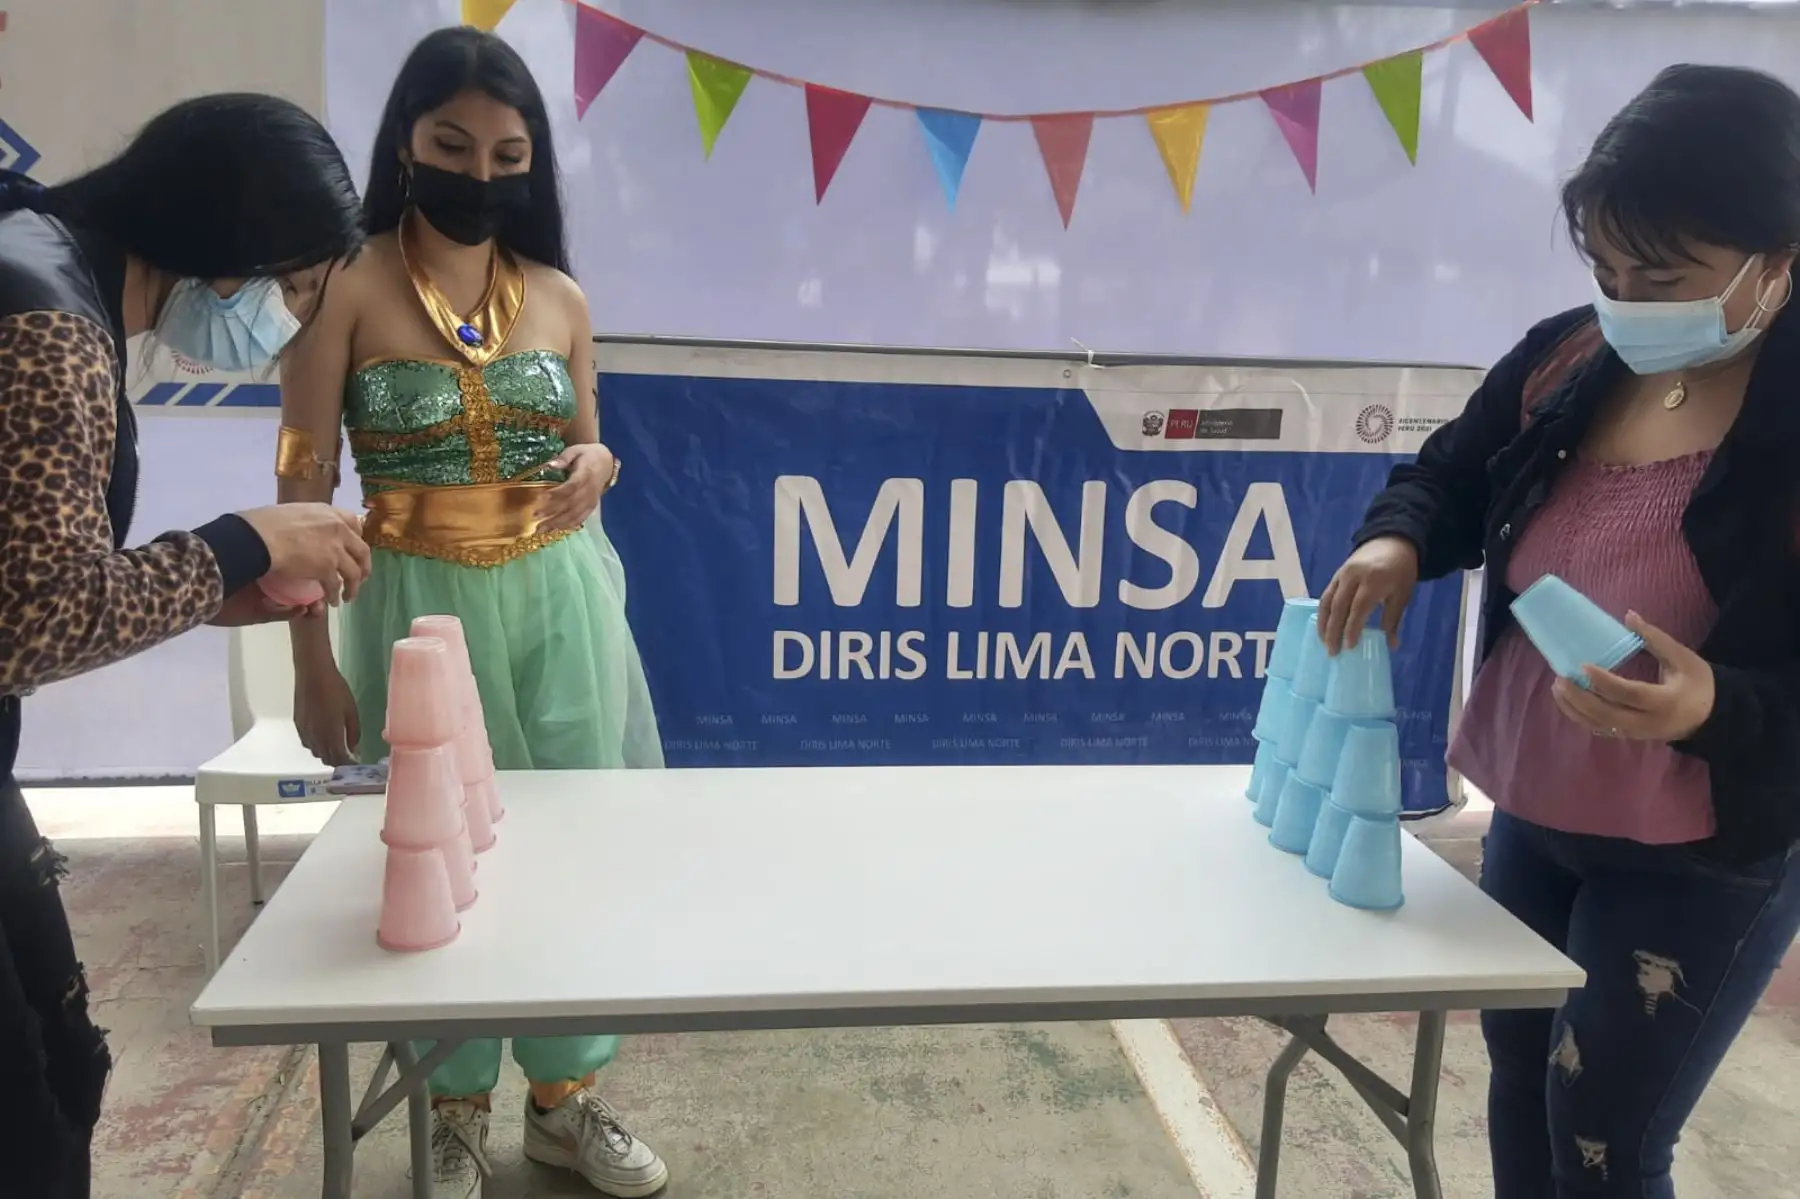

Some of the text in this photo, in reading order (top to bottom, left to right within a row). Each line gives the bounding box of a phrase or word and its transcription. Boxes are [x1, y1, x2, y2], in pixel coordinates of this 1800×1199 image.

[773, 475, 1309, 610] MINSA
[773, 630, 1279, 680] DIRIS LIMA NORT
[761, 713, 797, 724] MINSA
[831, 713, 868, 724] MINSA
[894, 712, 931, 724] MINSA
[963, 711, 999, 724] MINSA
